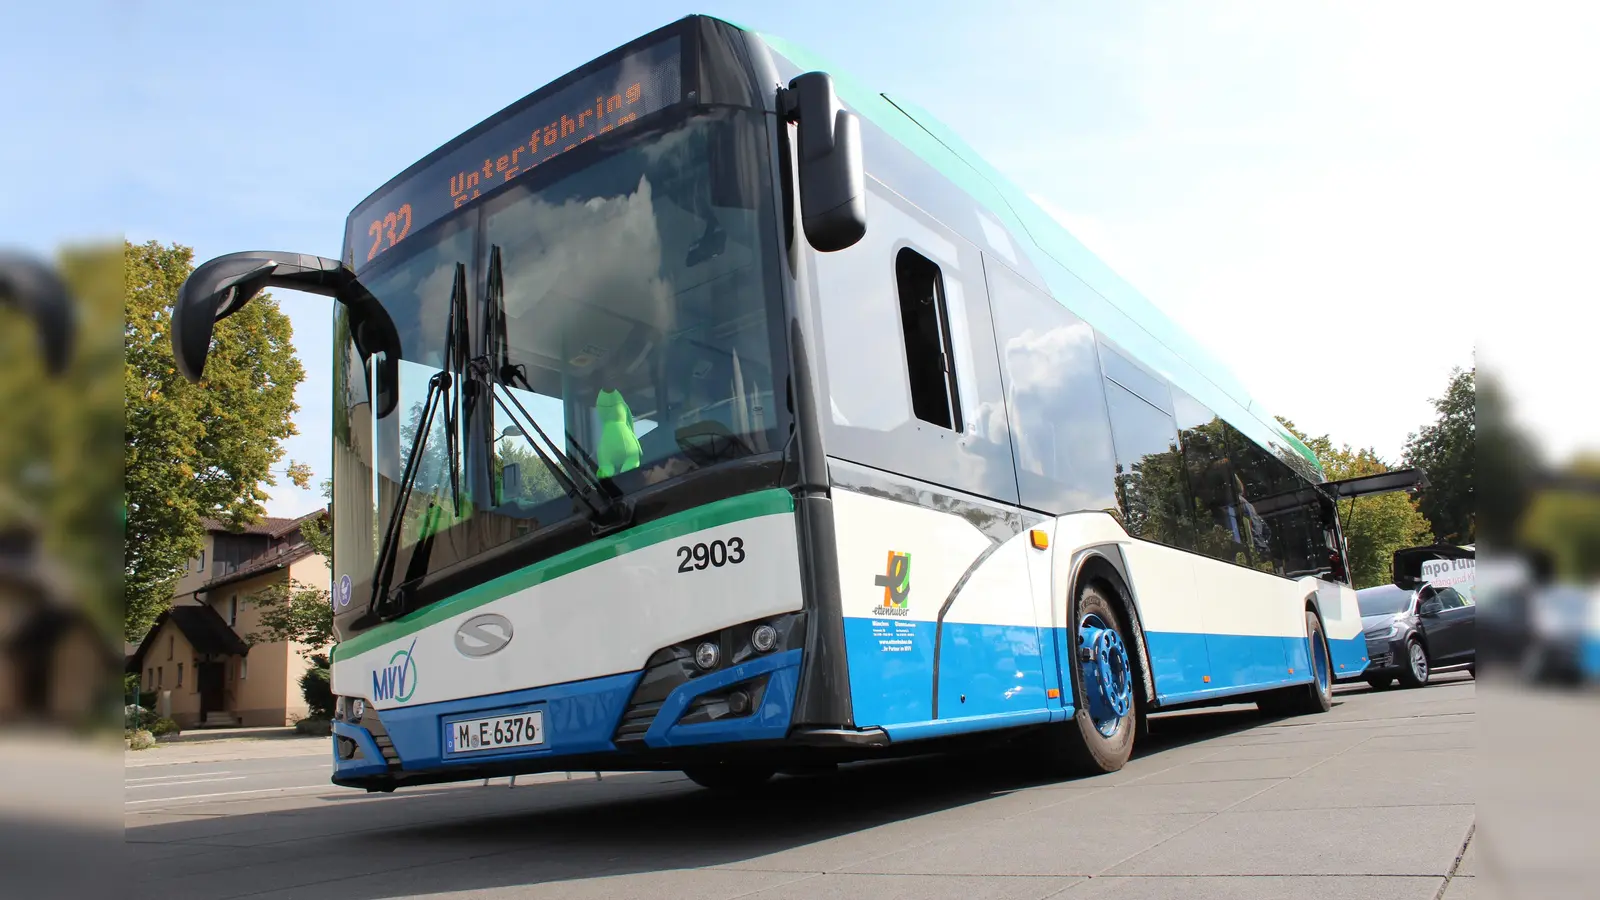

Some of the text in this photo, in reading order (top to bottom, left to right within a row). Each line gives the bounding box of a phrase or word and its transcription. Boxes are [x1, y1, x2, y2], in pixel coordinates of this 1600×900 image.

[449, 82, 640, 197] Unterföhring
[676, 536, 746, 573] 2903
[373, 637, 417, 701] MVV
[459, 724, 470, 748] M
